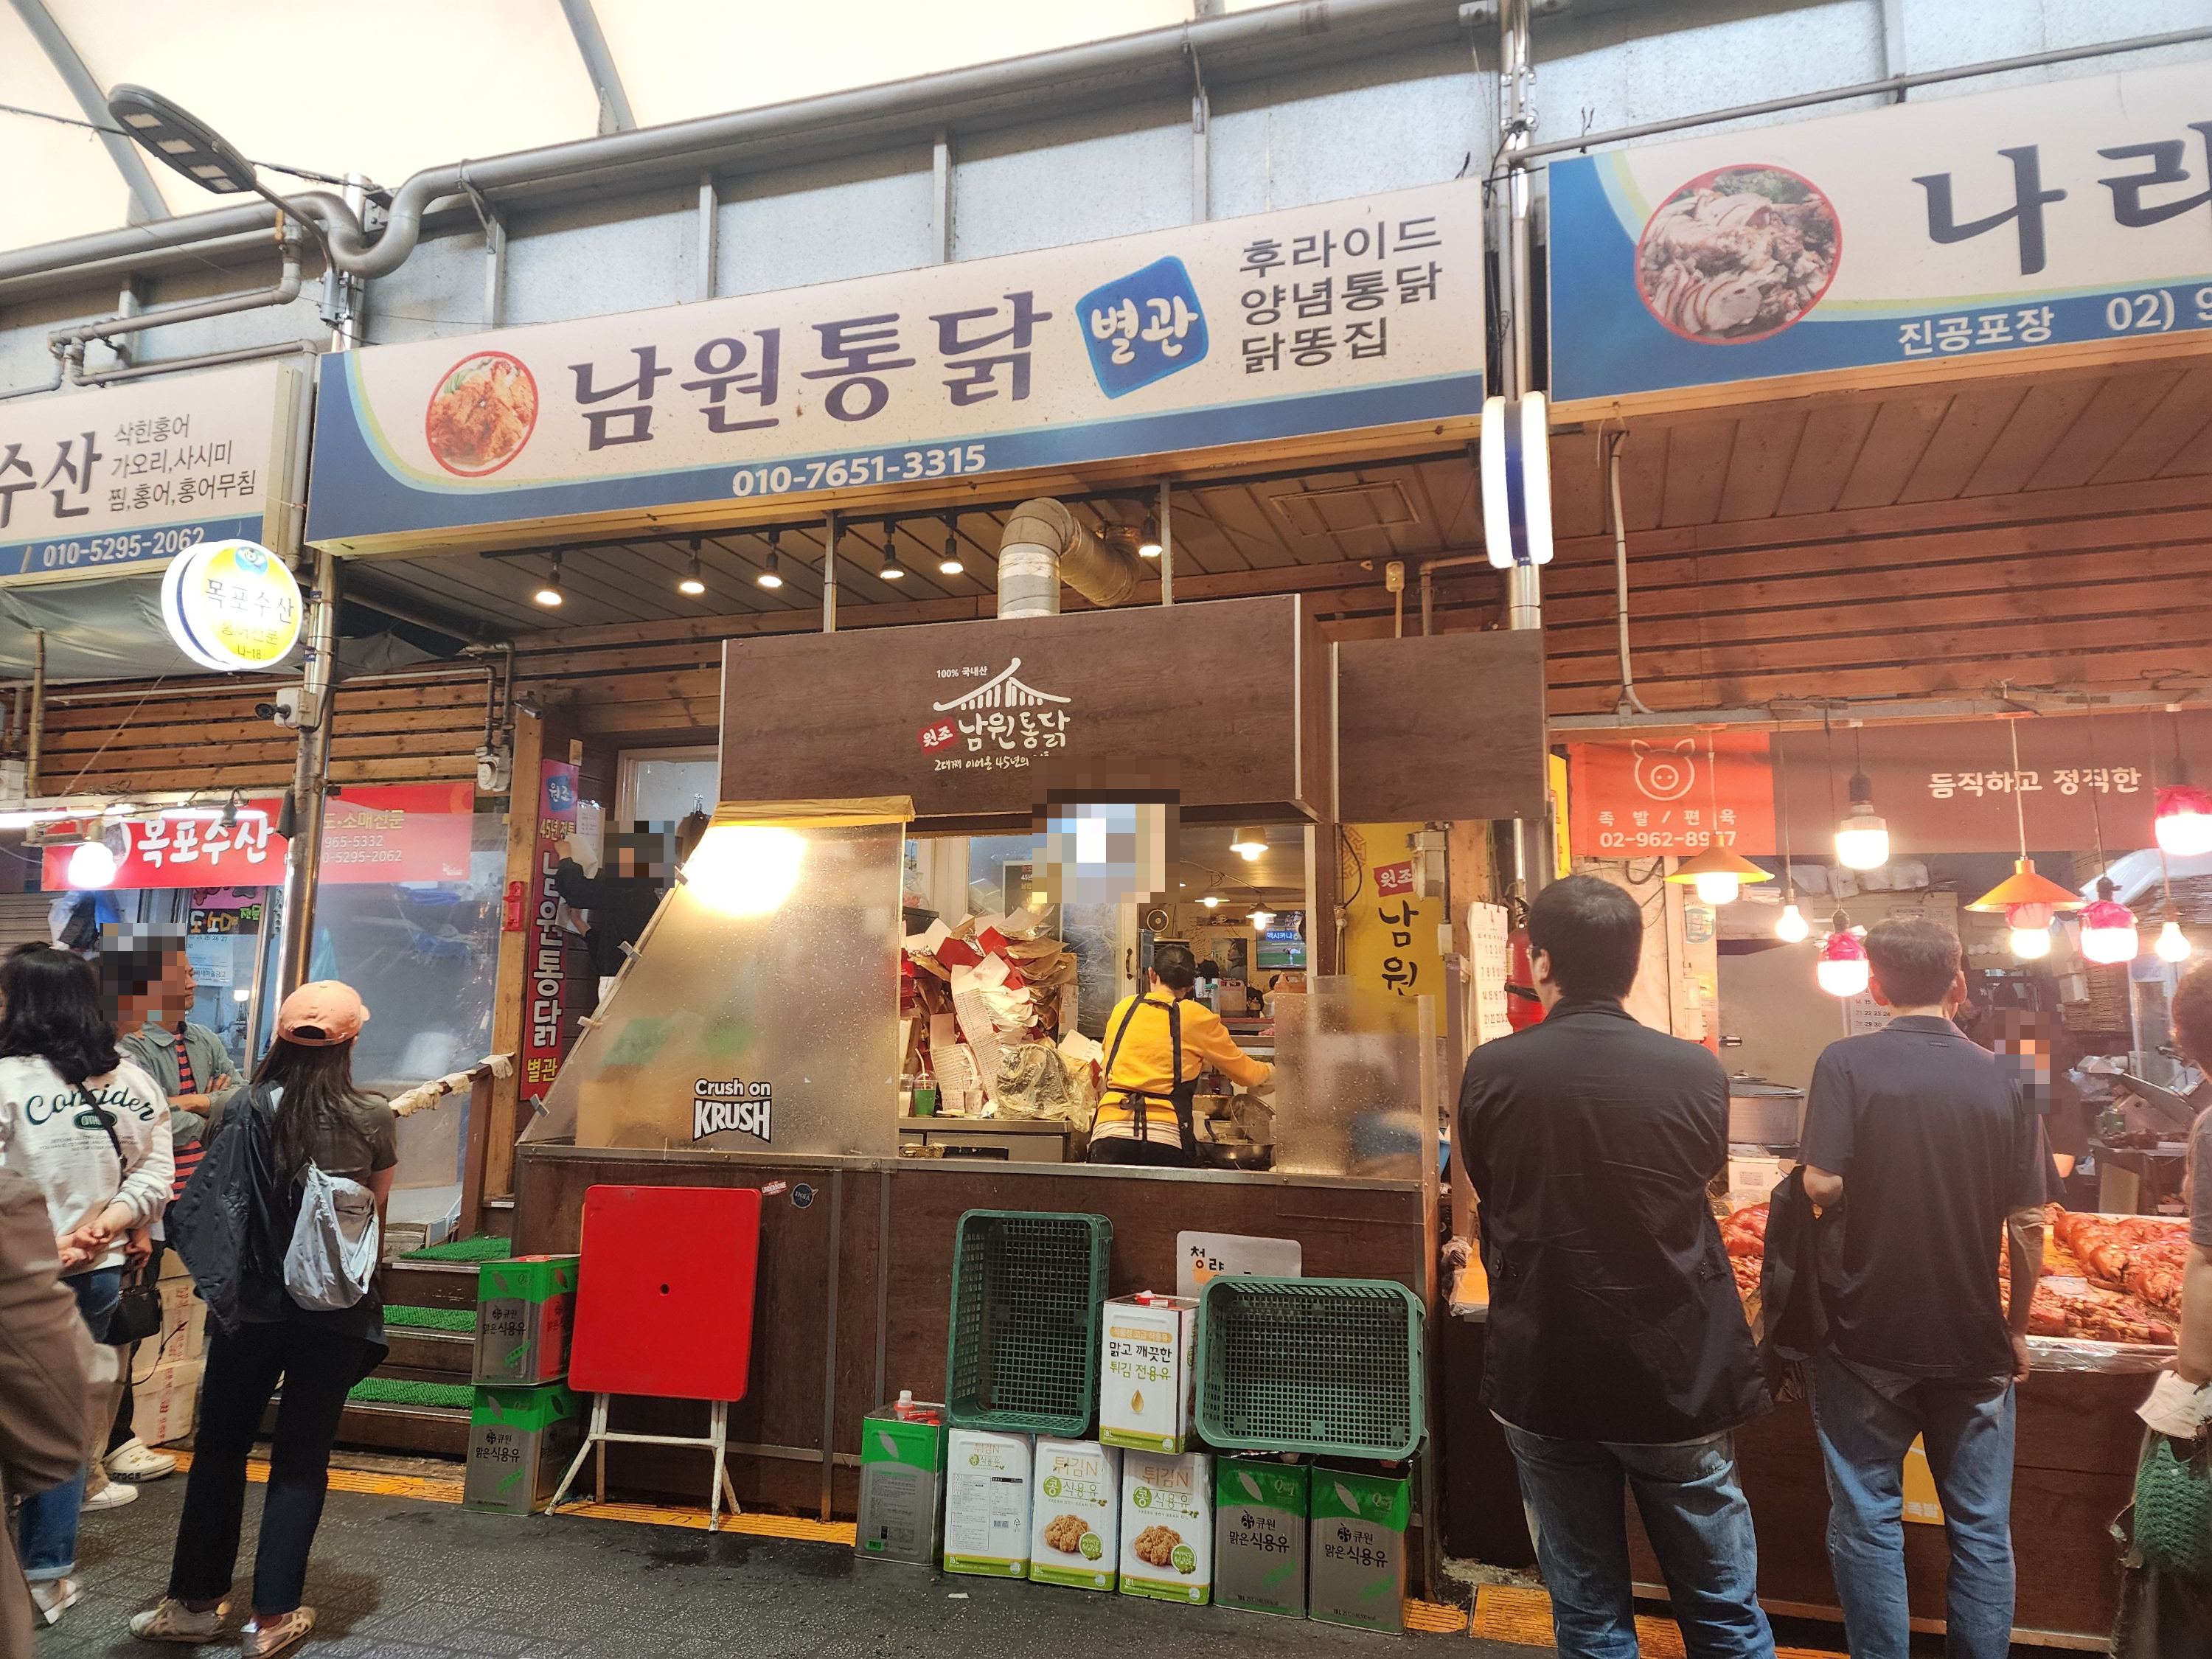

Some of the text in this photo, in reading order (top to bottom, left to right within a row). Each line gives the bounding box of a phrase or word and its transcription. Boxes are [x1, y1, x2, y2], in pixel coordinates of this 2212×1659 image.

[1239, 215, 1443, 278] 후라이드
[1240, 260, 1443, 326] 양념통닭
[1091, 295, 1197, 365] 별관
[1898, 306, 2055, 355] 진공포장
[2106, 290, 2175, 331] 02)
[1242, 317, 1388, 374] 닭똥집
[568, 291, 1052, 451] 남원통닭
[114, 414, 189, 445] 삭힌홍어
[111, 440, 232, 480] 가오리,사시미
[733, 445, 986, 497] 010-7651-3315
[0, 431, 102, 528] 수산
[108, 469, 257, 512] 찜,홍어,홍어무침
[44, 527, 205, 567] 010-5295-2062
[206, 579, 294, 624] 목포수산
[936, 666, 988, 678] 100% 국내산
[923, 709, 1071, 751] 원조 남원통닭
[934, 755, 1029, 771] 2대째 이어온 45년의
[549, 782, 571, 802] 원조
[1928, 767, 2142, 799] 듬직하고 정직한
[540, 818, 558, 841] 45년
[1600, 831, 1737, 848] 02-962-897
[136, 817, 276, 869] 목포수산
[1380, 869, 1413, 888] 원조
[527, 1058, 558, 1083] 별관
[695, 1079, 771, 1096] Crush on
[693, 1099, 771, 1142] KRUSH
[1110, 1342, 1172, 1363] 맑고 깨끗한
[1110, 1360, 1171, 1382] 튀김 전용유
[498, 1434, 512, 1445] 큐원
[974, 1442, 1001, 1454] 튀김N
[1053, 1456, 1098, 1477] 튀김N
[1142, 1467, 1189, 1487] 튀김N
[1046, 1479, 1099, 1498] 콩 식용유
[1135, 1489, 1190, 1509] 콩 식용유
[1256, 1517, 1276, 1531] 큐원
[1353, 1531, 1373, 1545] 큐원
